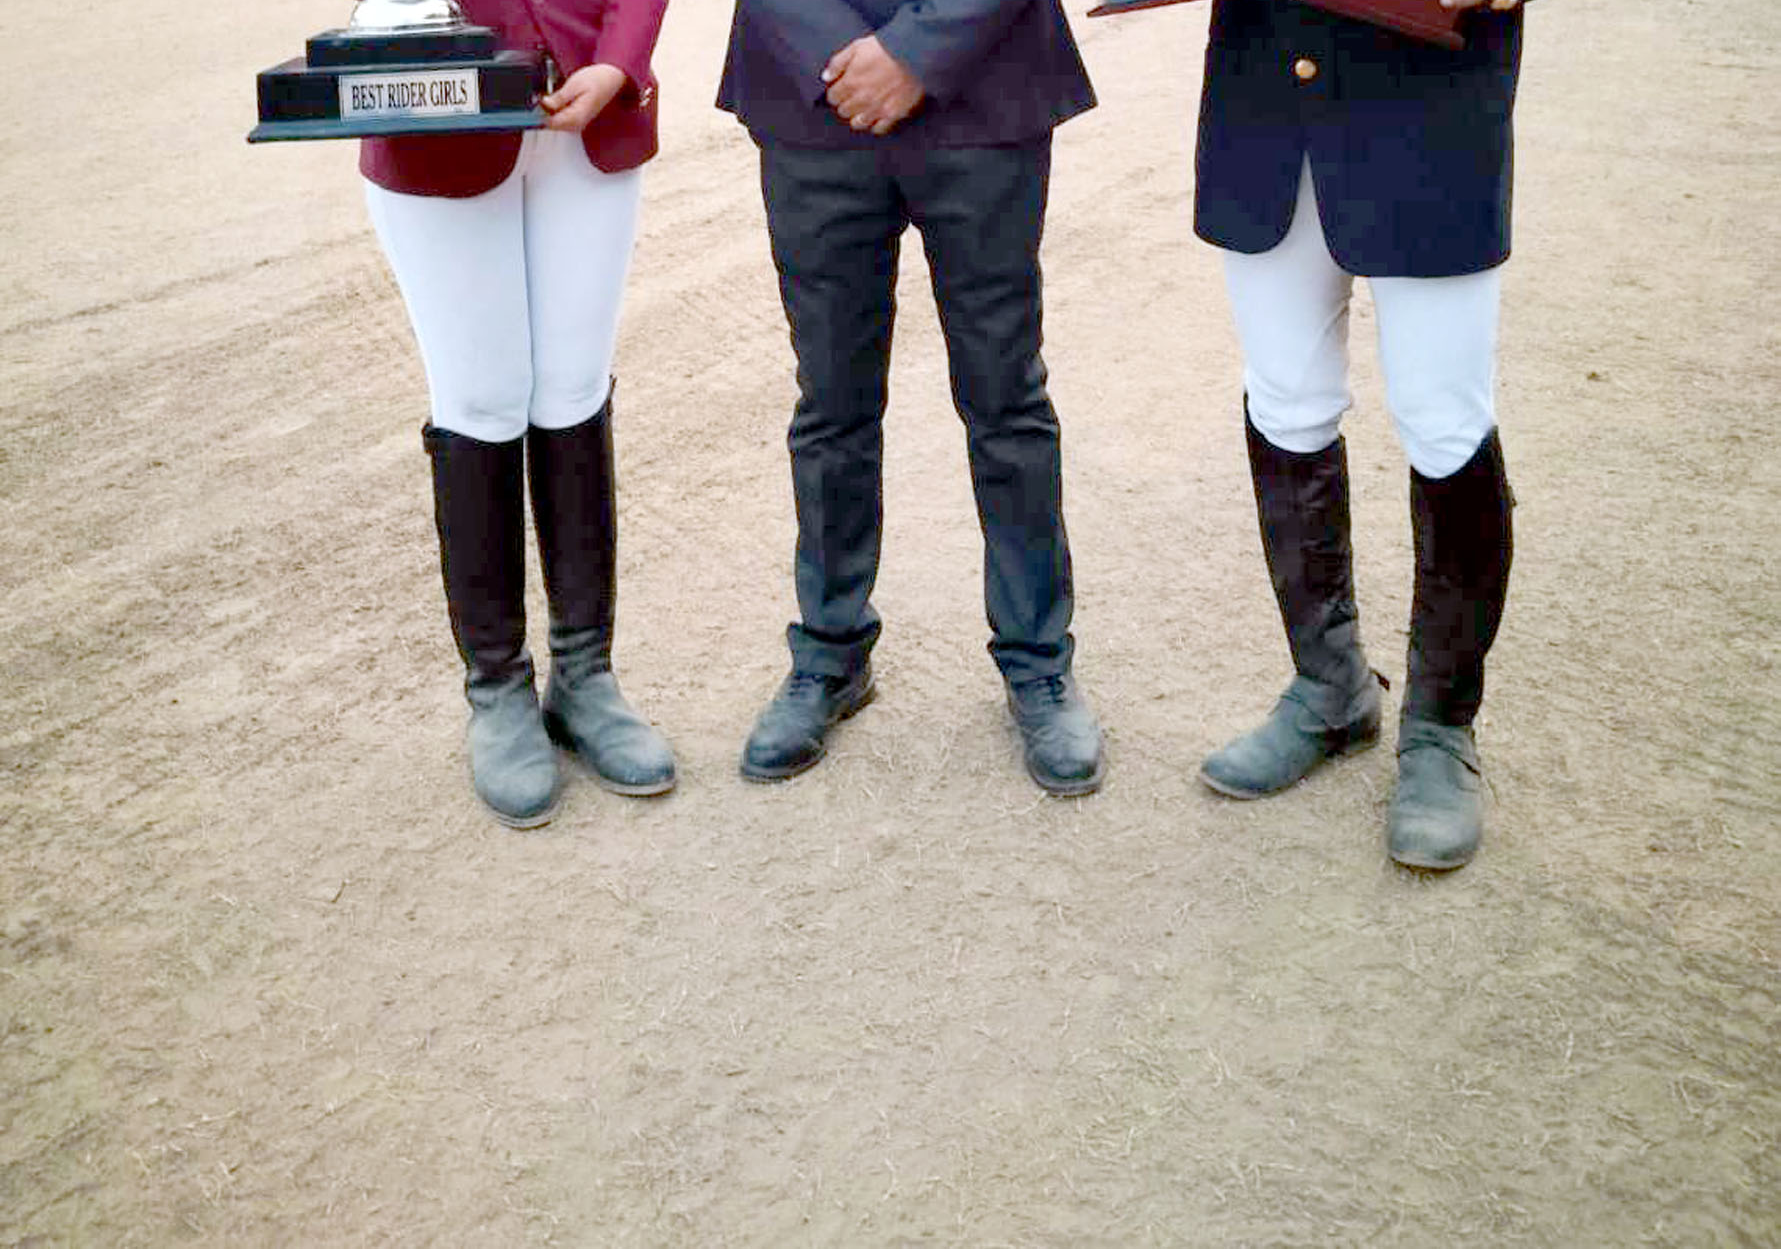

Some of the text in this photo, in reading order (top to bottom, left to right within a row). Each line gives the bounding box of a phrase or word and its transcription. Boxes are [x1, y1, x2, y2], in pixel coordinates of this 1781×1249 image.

[351, 80, 468, 110] BEST RIDER GIRLS
